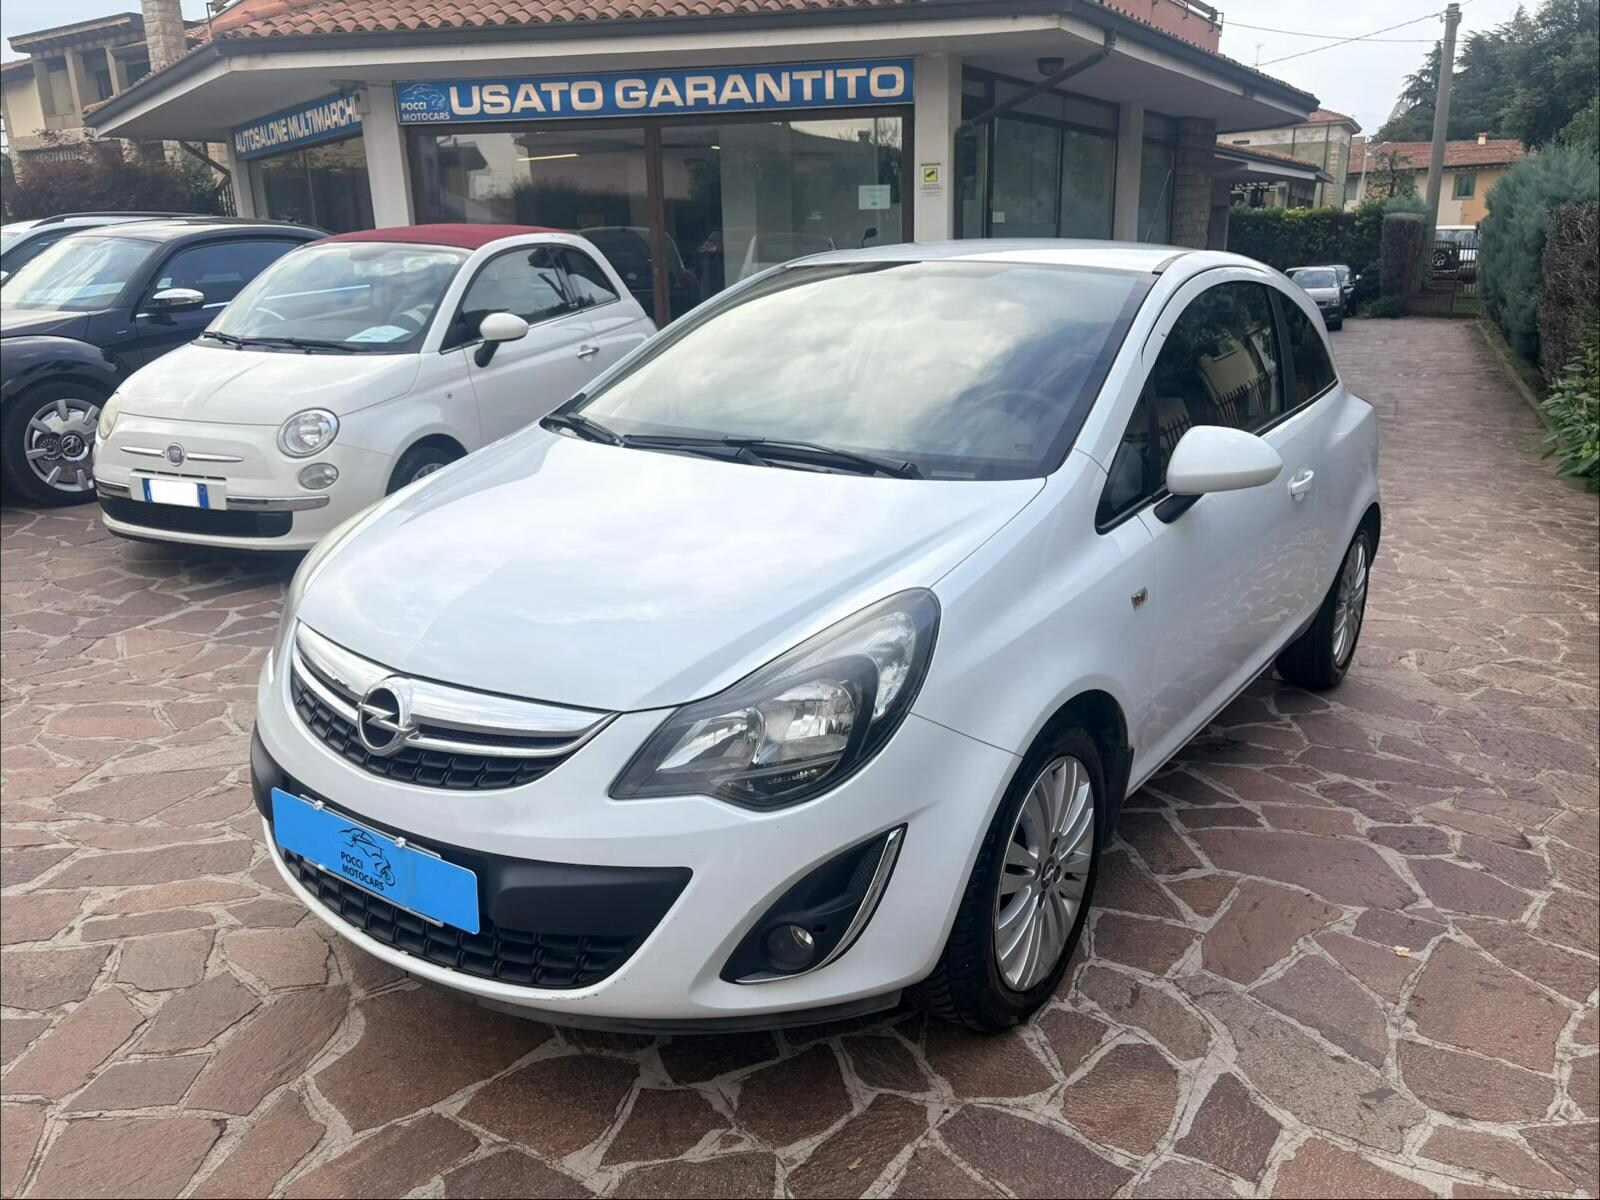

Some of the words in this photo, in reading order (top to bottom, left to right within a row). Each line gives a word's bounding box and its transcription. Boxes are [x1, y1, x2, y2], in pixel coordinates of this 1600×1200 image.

[450, 81, 604, 116] USATO
[615, 65, 905, 109] GARANTITO
[400, 102, 427, 111] POCCI
[402, 111, 450, 121] MOTOCARS
[235, 118, 289, 153] AUTOSALONE
[341, 851, 363, 870] POCCI
[342, 864, 385, 891] MOTOCARS
